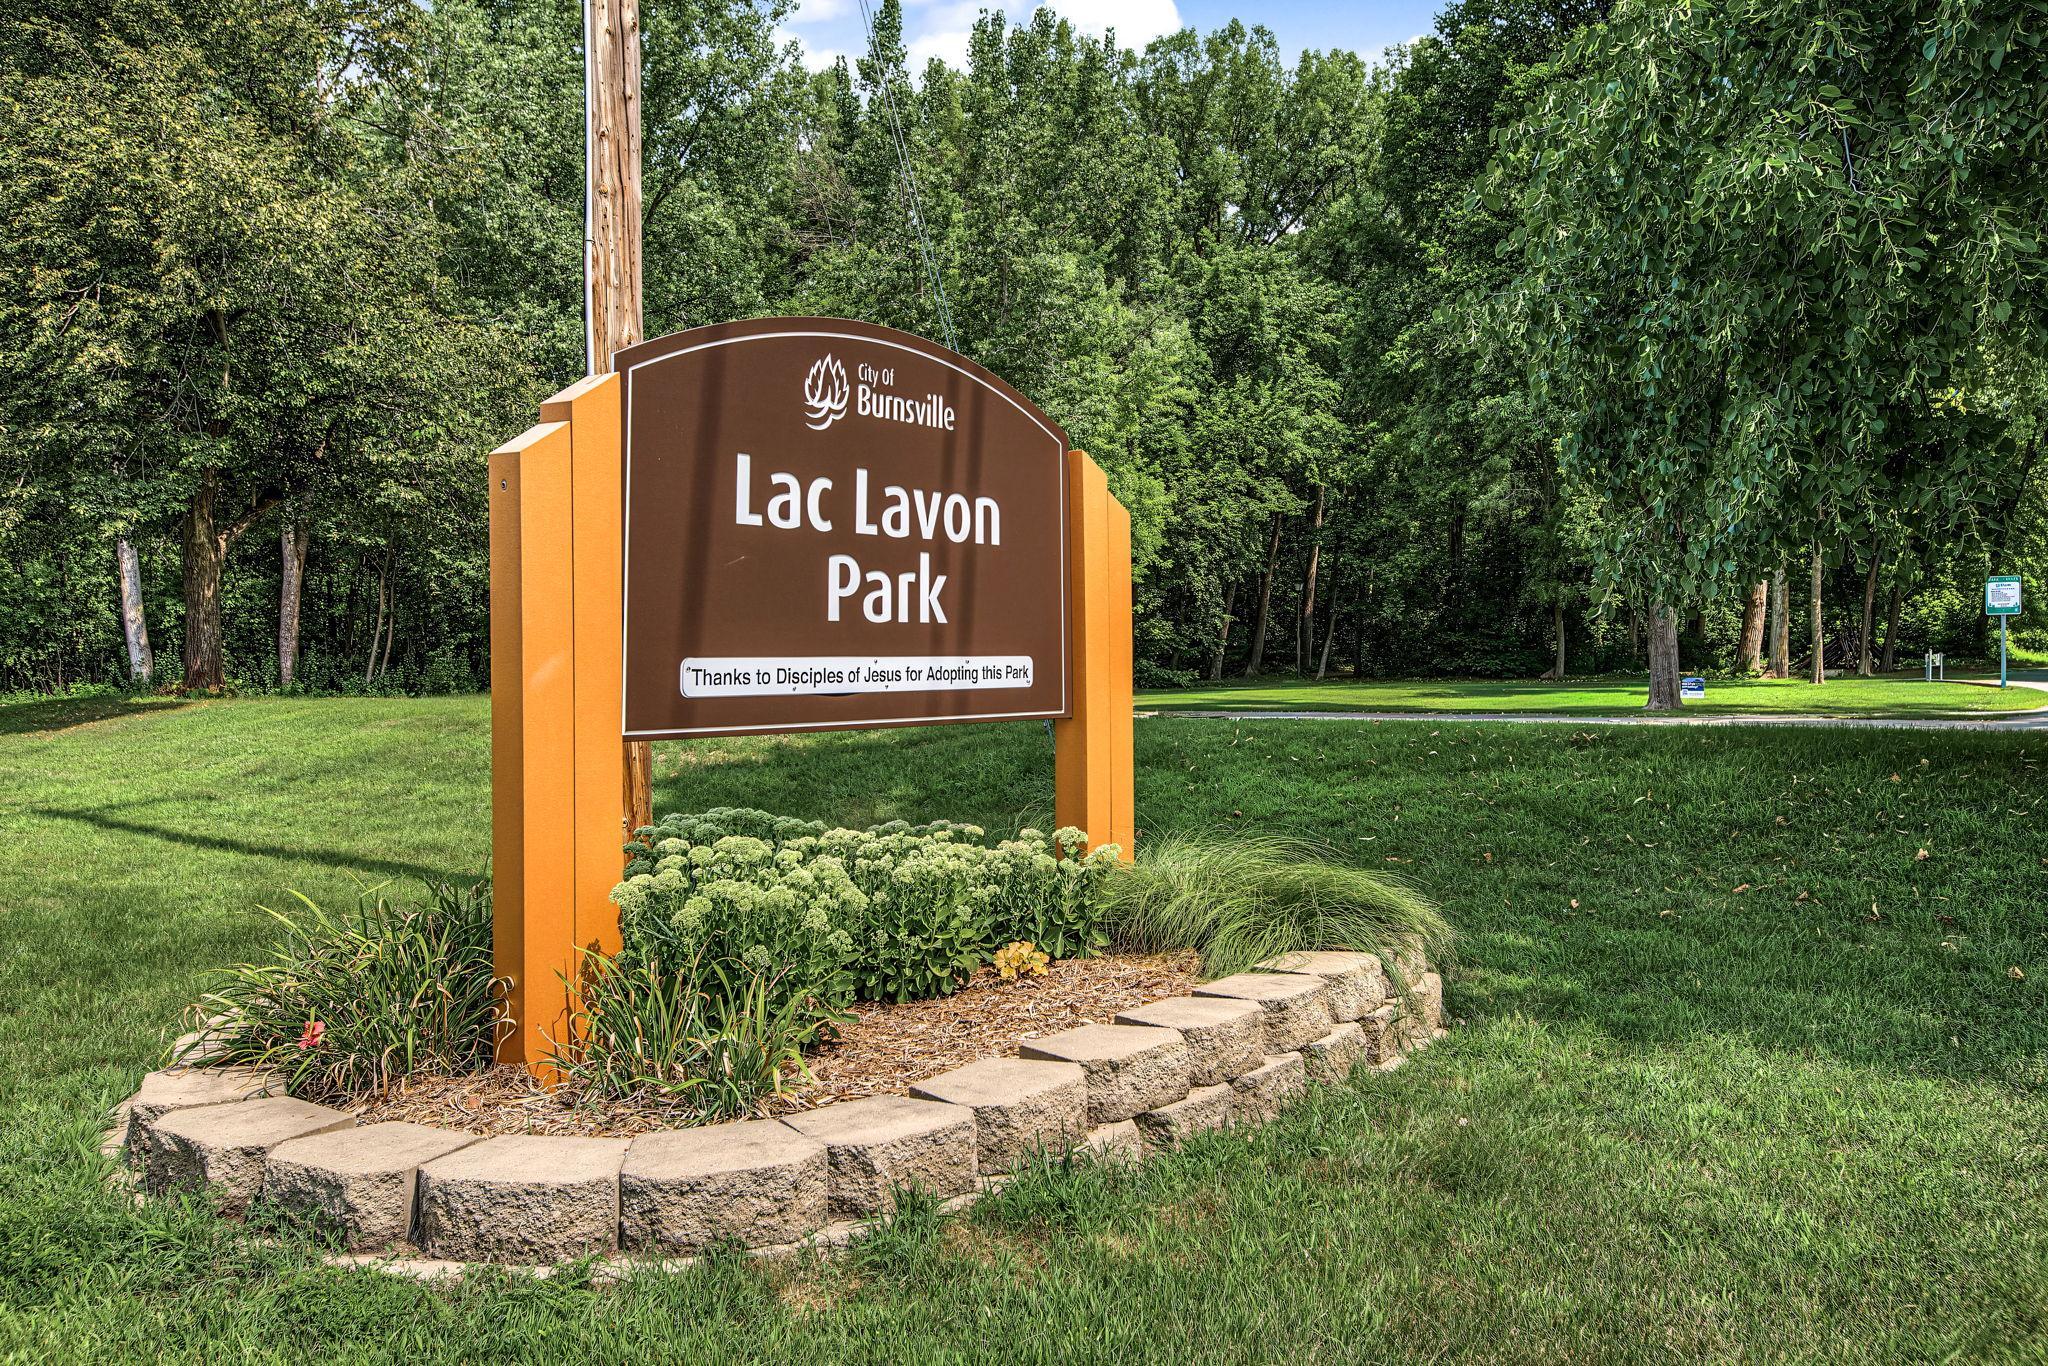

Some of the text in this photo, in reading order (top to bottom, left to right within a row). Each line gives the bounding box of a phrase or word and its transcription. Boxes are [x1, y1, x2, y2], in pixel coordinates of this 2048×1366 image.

[859, 363, 895, 387] City Of
[858, 384, 955, 431] Burnsville
[736, 453, 1001, 546] Lac Lavon
[828, 552, 949, 624] Park
[691, 664, 1029, 688] Thanks to Disciples of Jesus for Adopting this Park
